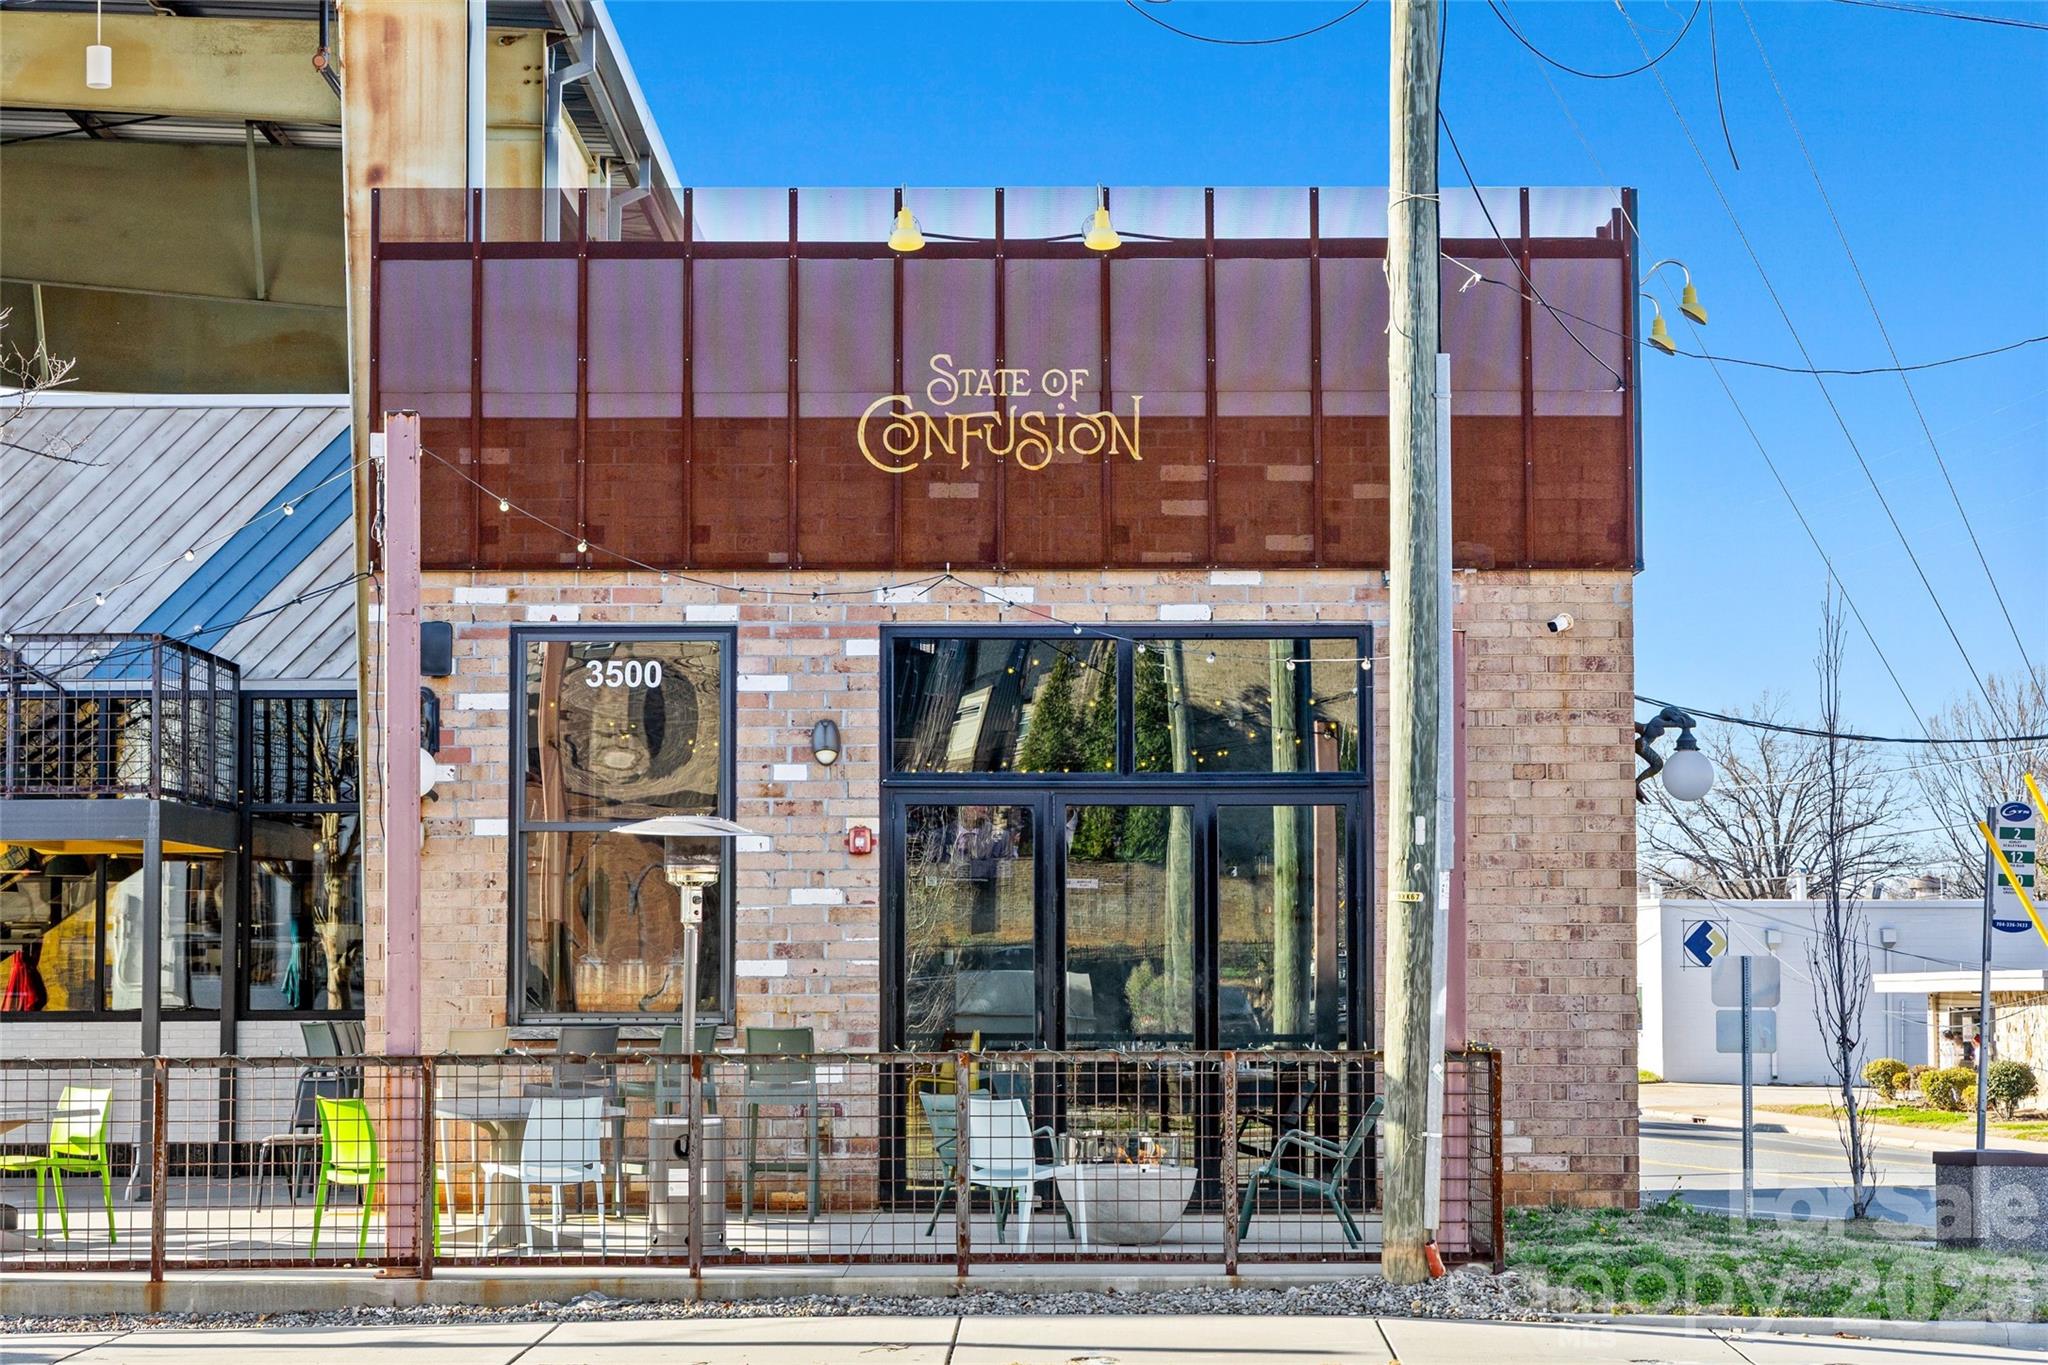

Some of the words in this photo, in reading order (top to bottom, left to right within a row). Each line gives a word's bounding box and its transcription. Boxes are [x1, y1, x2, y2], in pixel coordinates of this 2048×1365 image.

[927, 354, 1031, 406] STATE
[1041, 368, 1089, 402] OF
[857, 395, 1143, 473] CONFUSION
[585, 660, 662, 688] 3500
[2014, 828, 2021, 840] 2
[2010, 851, 2024, 863] 12
